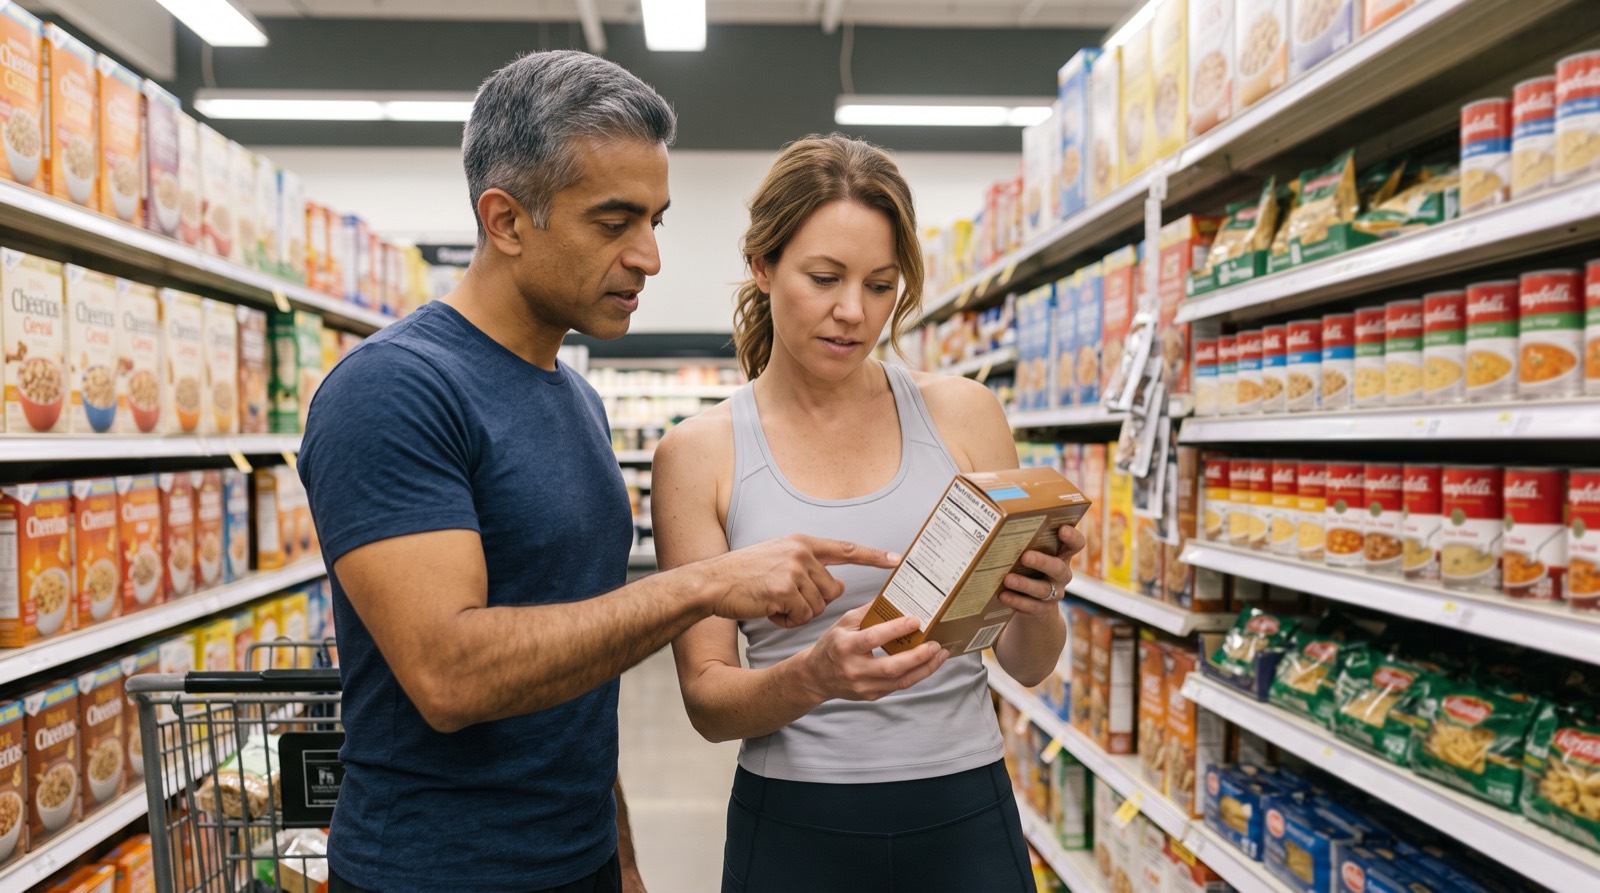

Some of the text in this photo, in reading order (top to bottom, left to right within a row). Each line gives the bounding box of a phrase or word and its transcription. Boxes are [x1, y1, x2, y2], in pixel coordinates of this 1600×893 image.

[953, 482, 997, 522] Nutrition Facts
[0, 743, 22, 769] erios
